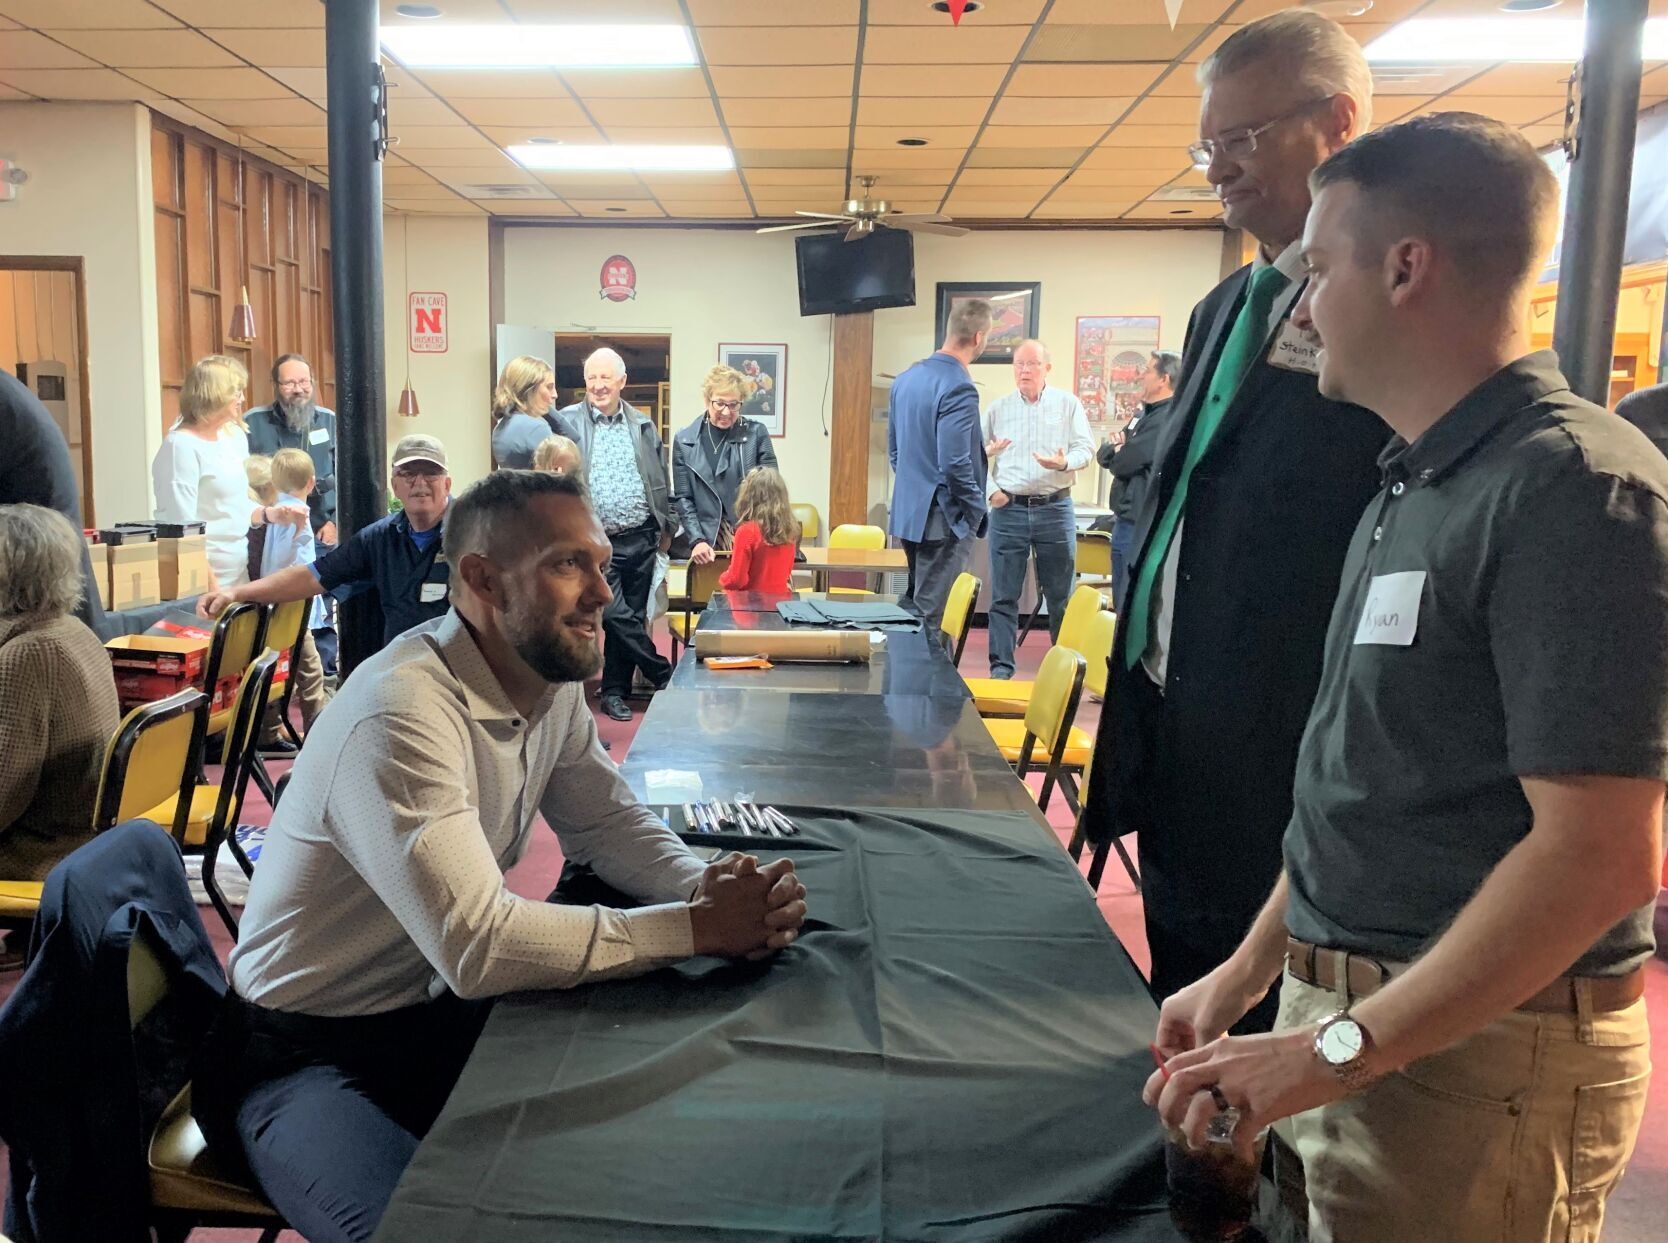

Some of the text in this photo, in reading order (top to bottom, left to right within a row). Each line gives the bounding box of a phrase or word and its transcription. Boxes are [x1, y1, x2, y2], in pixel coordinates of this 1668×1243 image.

[412, 296, 445, 306] FAN CAVE
[415, 308, 442, 334] N
[414, 336, 445, 344] HUSKERS
